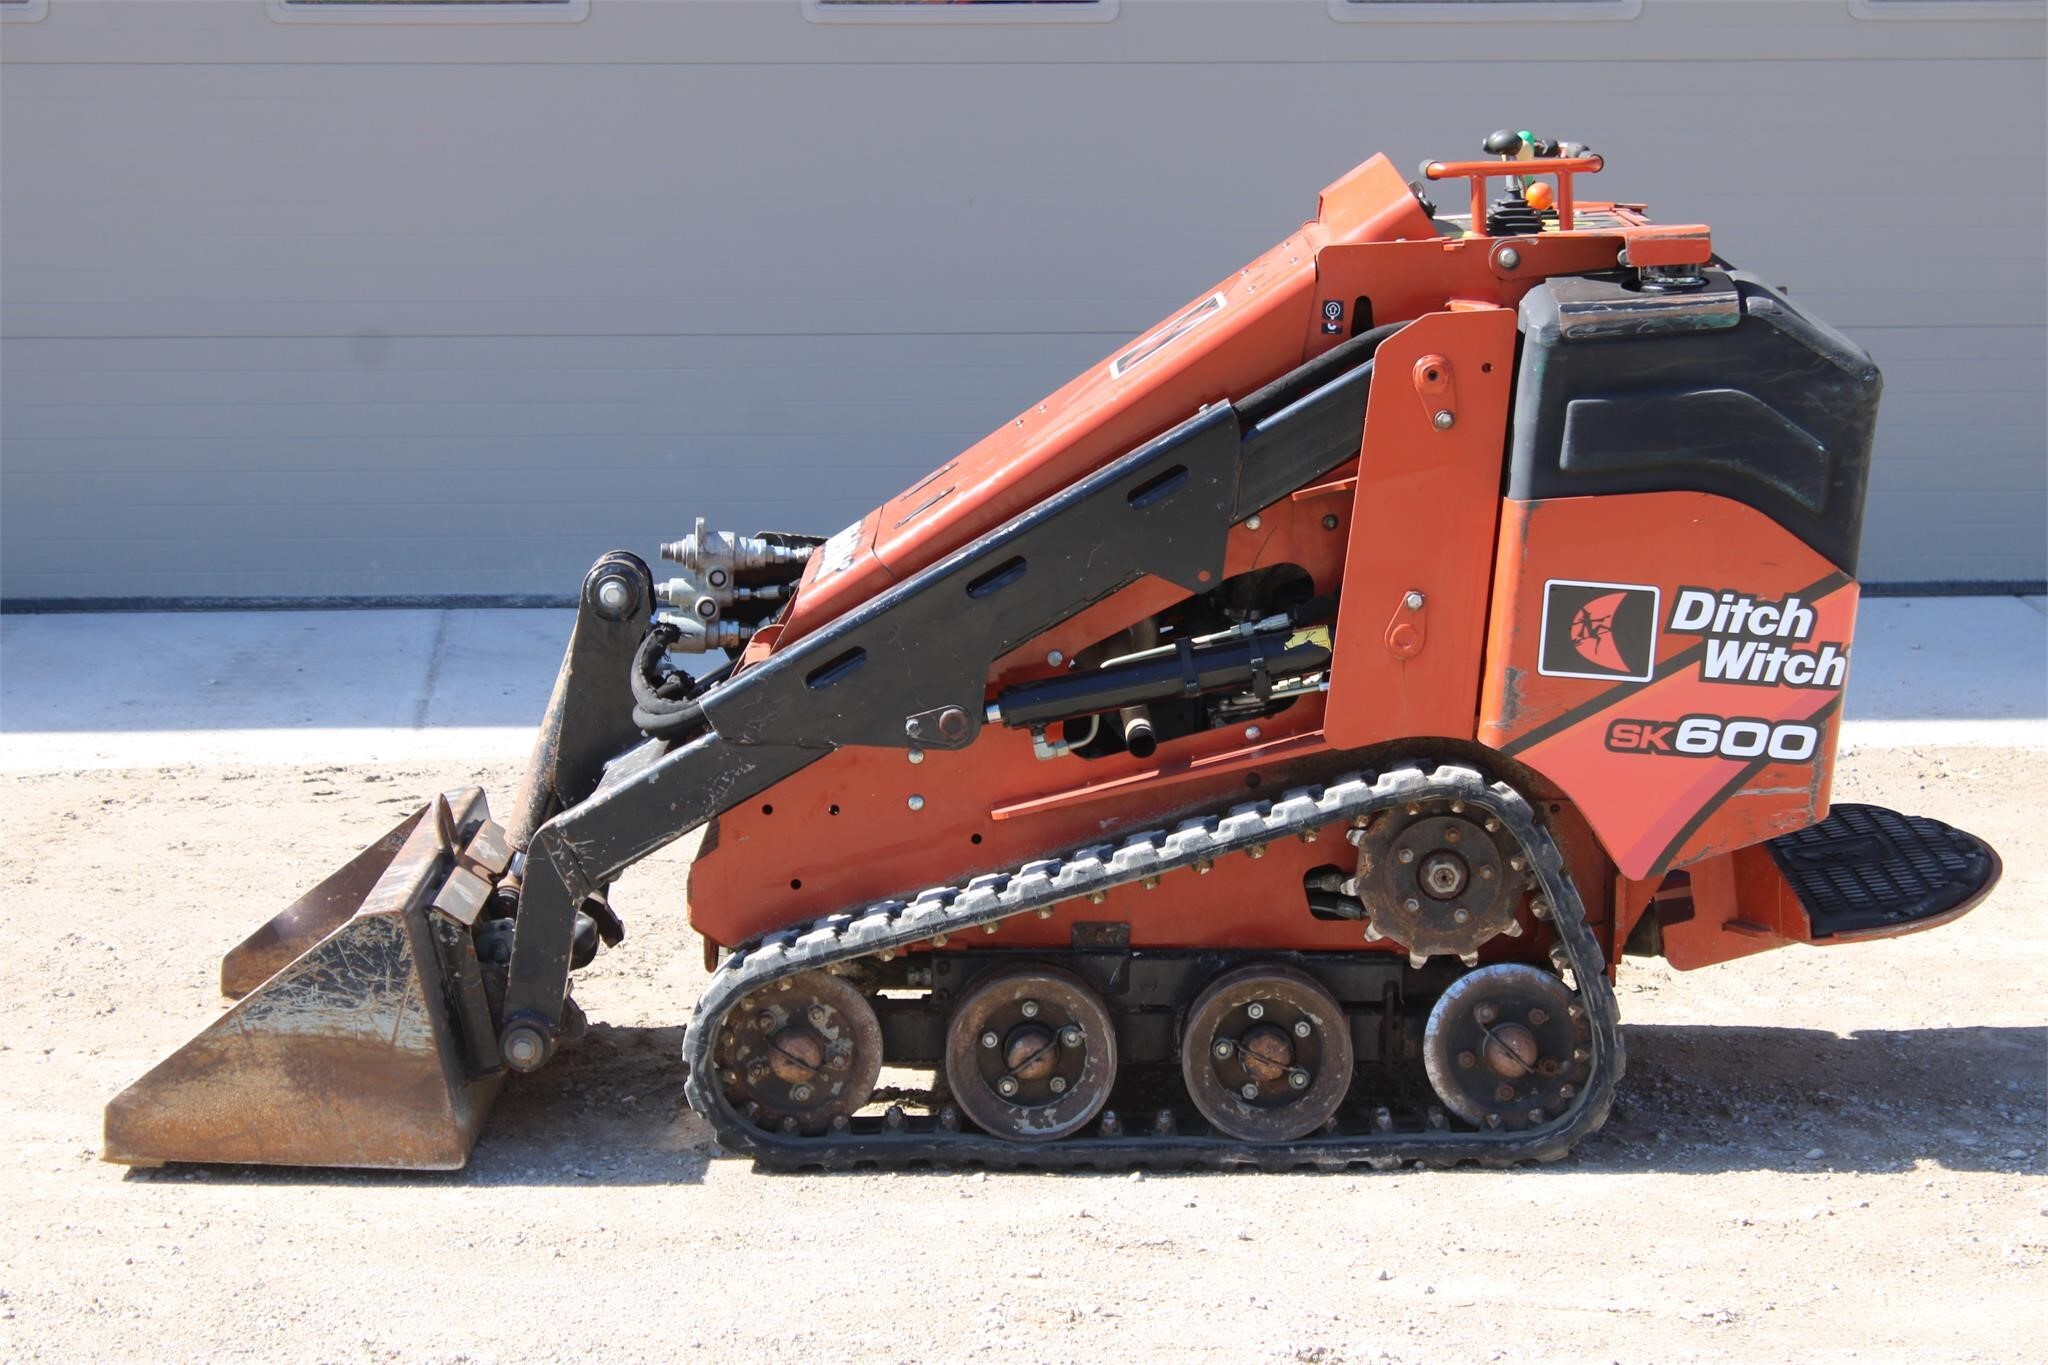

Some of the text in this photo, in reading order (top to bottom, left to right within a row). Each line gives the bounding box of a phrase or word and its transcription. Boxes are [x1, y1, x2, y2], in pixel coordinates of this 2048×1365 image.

[1671, 591, 1814, 638] Ditch
[1704, 640, 1846, 686] Witch
[1610, 718, 1818, 761] SK600
